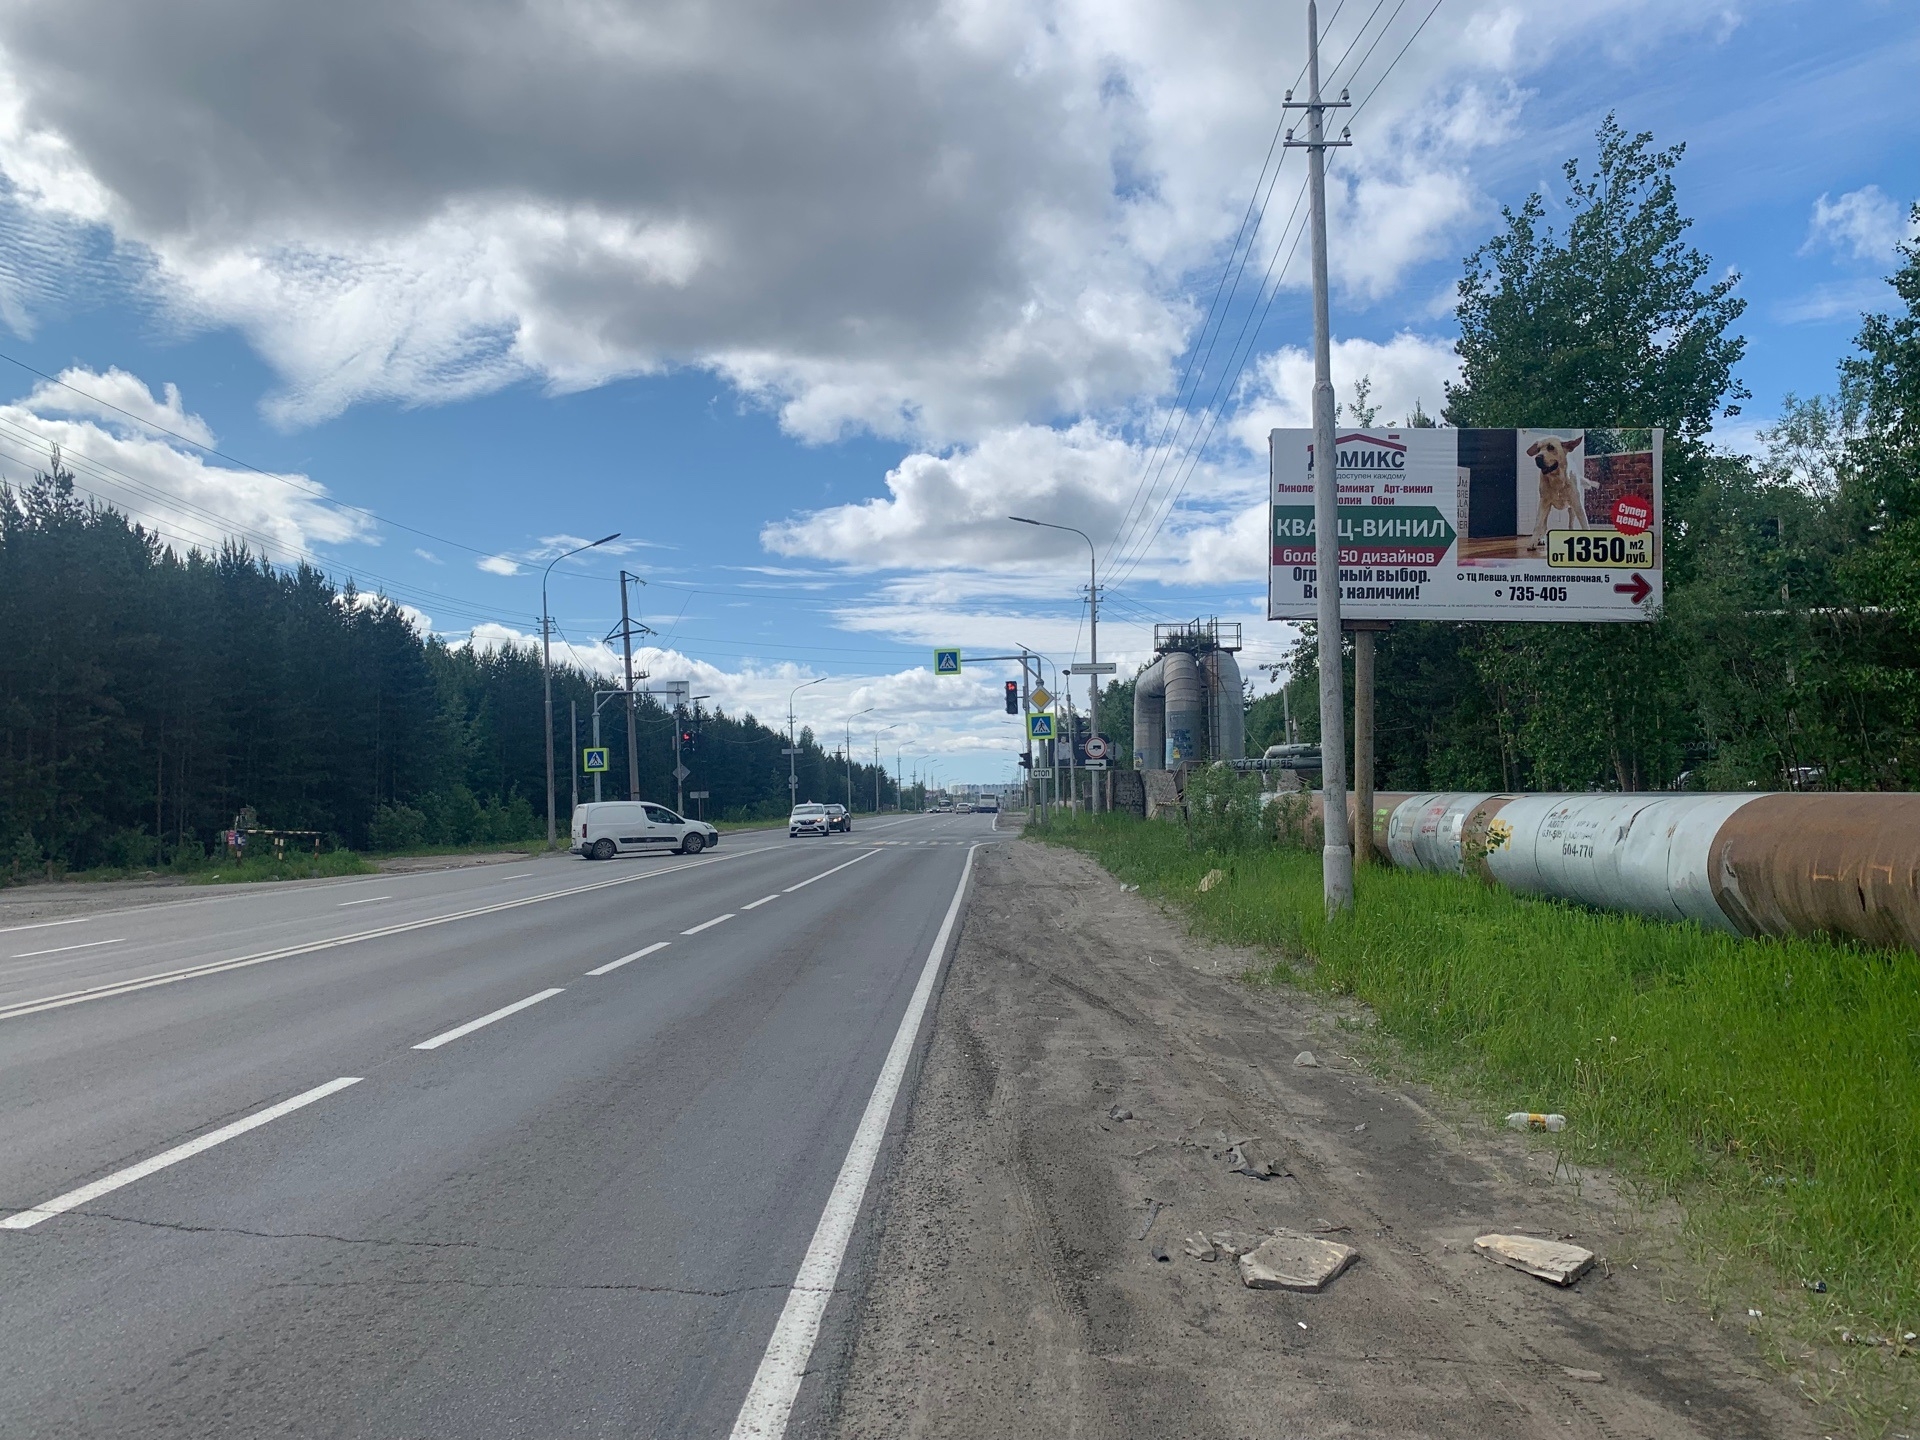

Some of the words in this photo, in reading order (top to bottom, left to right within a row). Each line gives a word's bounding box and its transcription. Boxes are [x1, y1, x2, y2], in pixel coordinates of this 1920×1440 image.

[1308, 451, 1405, 471] МИКС
[1278, 484, 1315, 493] Линоле
[1384, 483, 1433, 494] Арт-винил
[1372, 496, 1395, 505] Обои
[1618, 503, 1647, 518] Супер
[1616, 515, 1647, 528] цены!
[1277, 518, 1445, 541] КВАЦ-ВИНИЛ
[1552, 553, 1564, 562] от
[1563, 536, 1625, 563] 1350
[1626, 552, 1648, 564] руб.
[1630, 540, 1644, 550] м2
[1283, 549, 1317, 562] боле
[1338, 550, 1358, 562] 50
[1361, 549, 1435, 564] дизайнов
[1293, 566, 1372, 582] Огрный
[1376, 567, 1431, 583] выбор.
[1467, 573, 1476, 582] ТЦ
[1478, 573, 1509, 583] Левша,
[1510, 574, 1522, 583] ул.
[1524, 573, 1603, 584] Комплектовочная,
[1604, 574, 1610, 583] 5
[1347, 585, 1420, 599] наличии!
[1508, 586, 1568, 601] 735-405
[1033, 769, 1050, 777] СТОП
